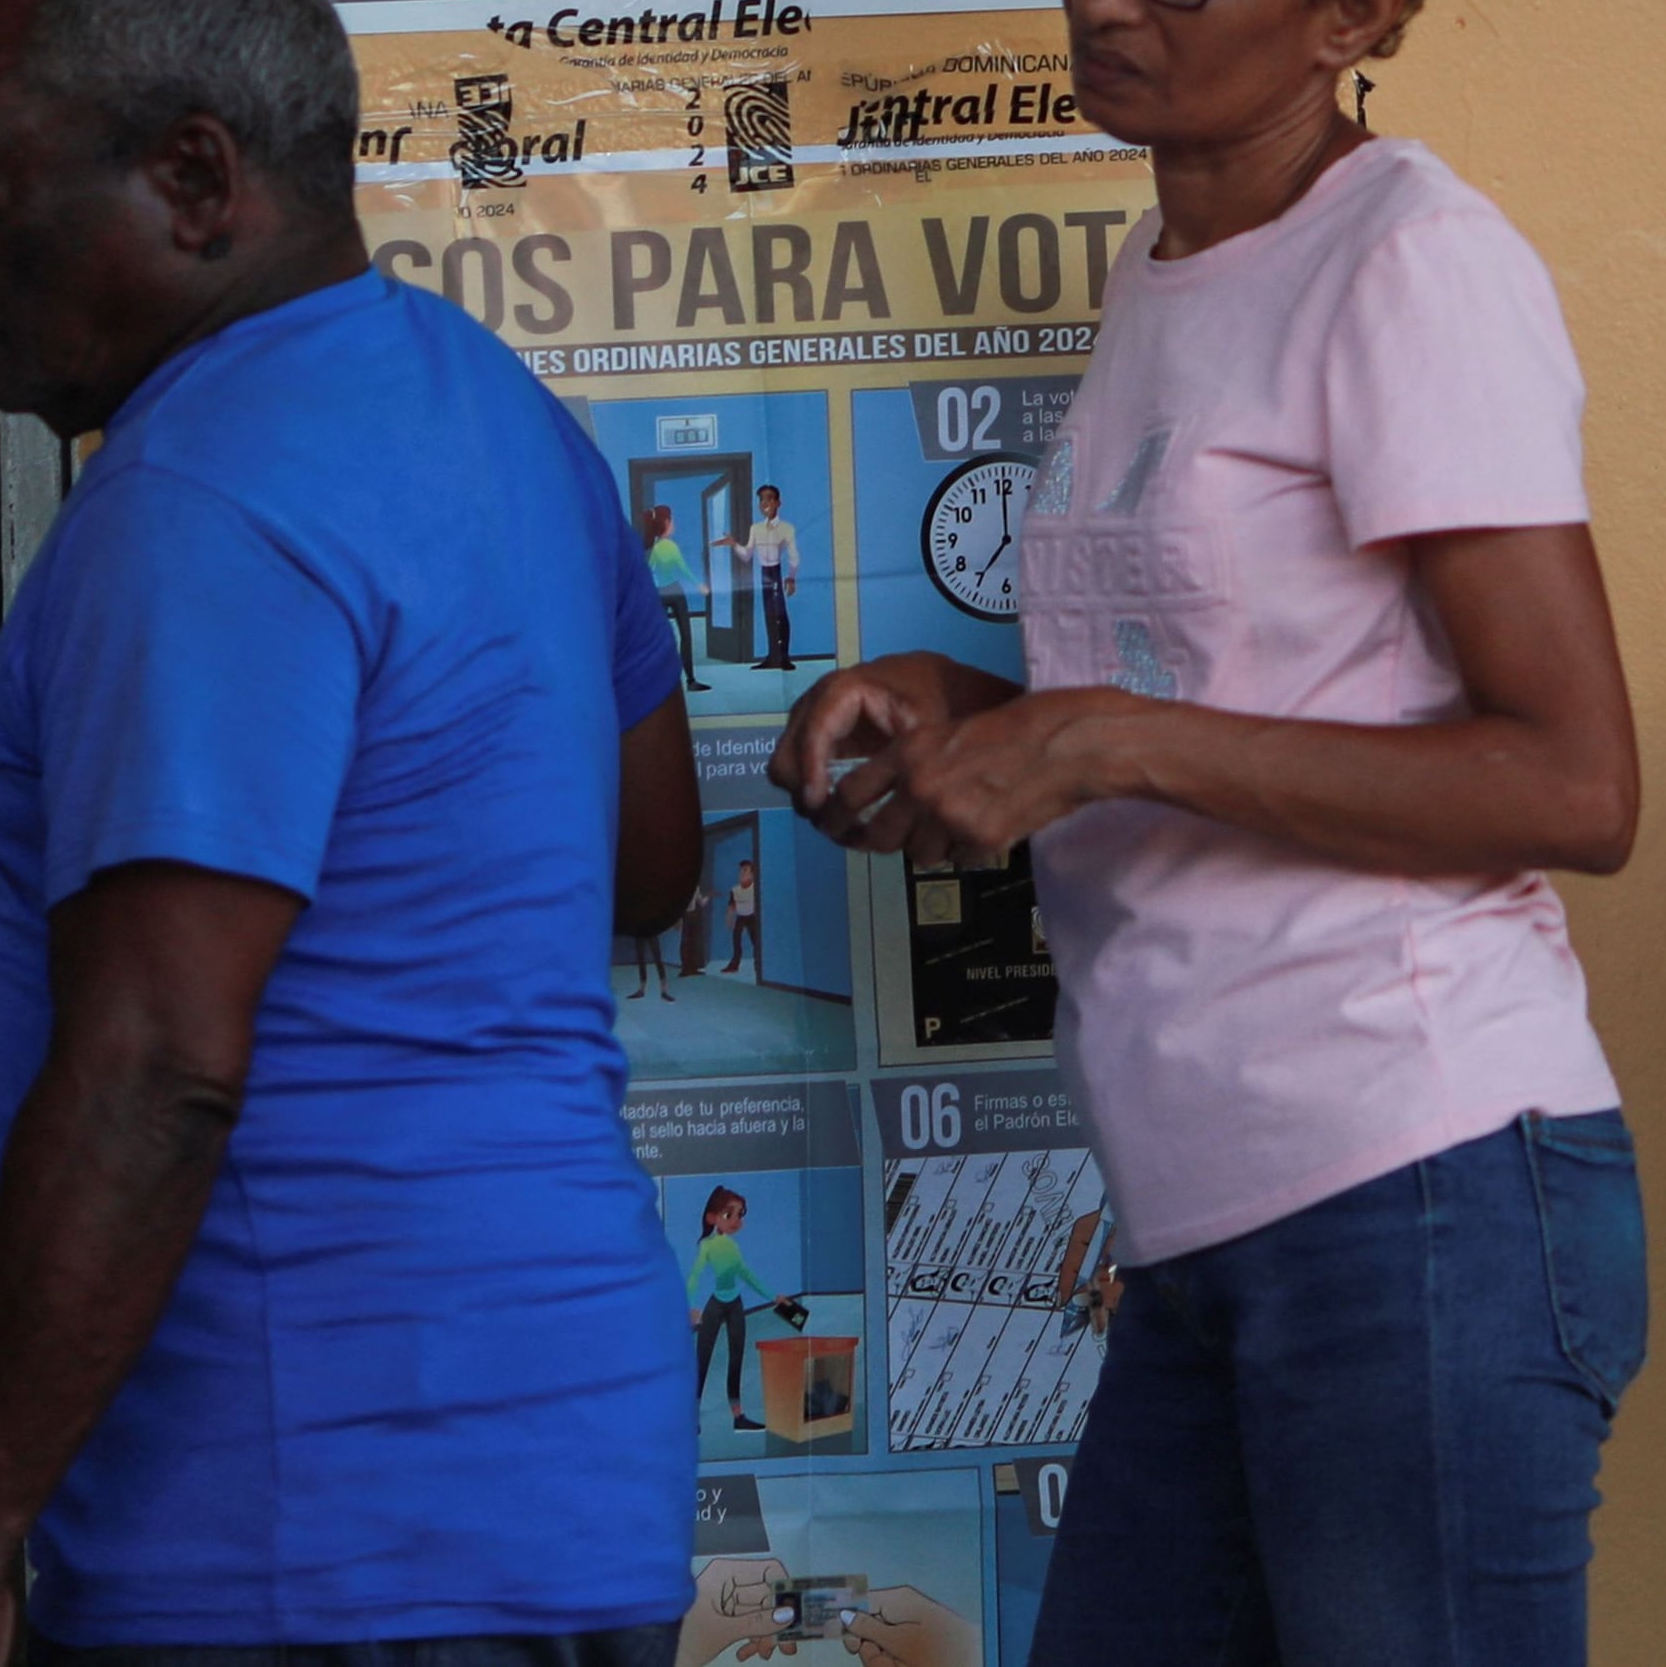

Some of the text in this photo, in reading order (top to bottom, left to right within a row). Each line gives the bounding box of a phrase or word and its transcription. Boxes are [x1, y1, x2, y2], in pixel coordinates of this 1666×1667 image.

[941, 53, 1075, 74] DOMINICAN
[945, 154, 1035, 171] GENERALES
[1039, 151, 1068, 167] DEL
[1071, 147, 1105, 164] AÑO
[1108, 148, 1148, 163] 2024
[476, 203, 516, 218] 2024
[611, 219, 891, 332] PARA
[573, 341, 742, 372] ORDINARIAS
[748, 333, 906, 366] GENERALES
[913, 330, 967, 358] DEL
[972, 324, 1030, 355] AÑO
[1022, 390, 1044, 406] La
[937, 386, 1002, 453] 02
[1022, 411, 1034, 424] a
[1022, 430, 1034, 443] a
[995, 479, 1013, 496] 12
[971, 489, 986, 505] 11
[953, 507, 973, 524] 10
[947, 533, 958, 549] 9
[956, 556, 967, 572] 8
[974, 571, 984, 588] 7
[1001, 579, 1012, 594] 6
[715, 735, 777, 756] Identid
[705, 763, 746, 781] para
[966, 966, 1002, 981] NIVEL
[923, 1017, 942, 1039] P
[674, 1100, 693, 1117] de
[698, 1100, 714, 1116] tu
[719, 1095, 805, 1119] preferencia,
[973, 1093, 1028, 1111] Firmas
[1032, 1095, 1044, 1107] o
[899, 1083, 962, 1150] 06
[974, 1113, 989, 1130] el
[992, 1109, 1051, 1131] Padrón
[648, 1119, 684, 1138] sello
[686, 1116, 727, 1136] hacia
[730, 1115, 776, 1135] afuera
[791, 1114, 806, 1130] la
[711, 1487, 723, 1505] y
[717, 1505, 728, 1523] y
